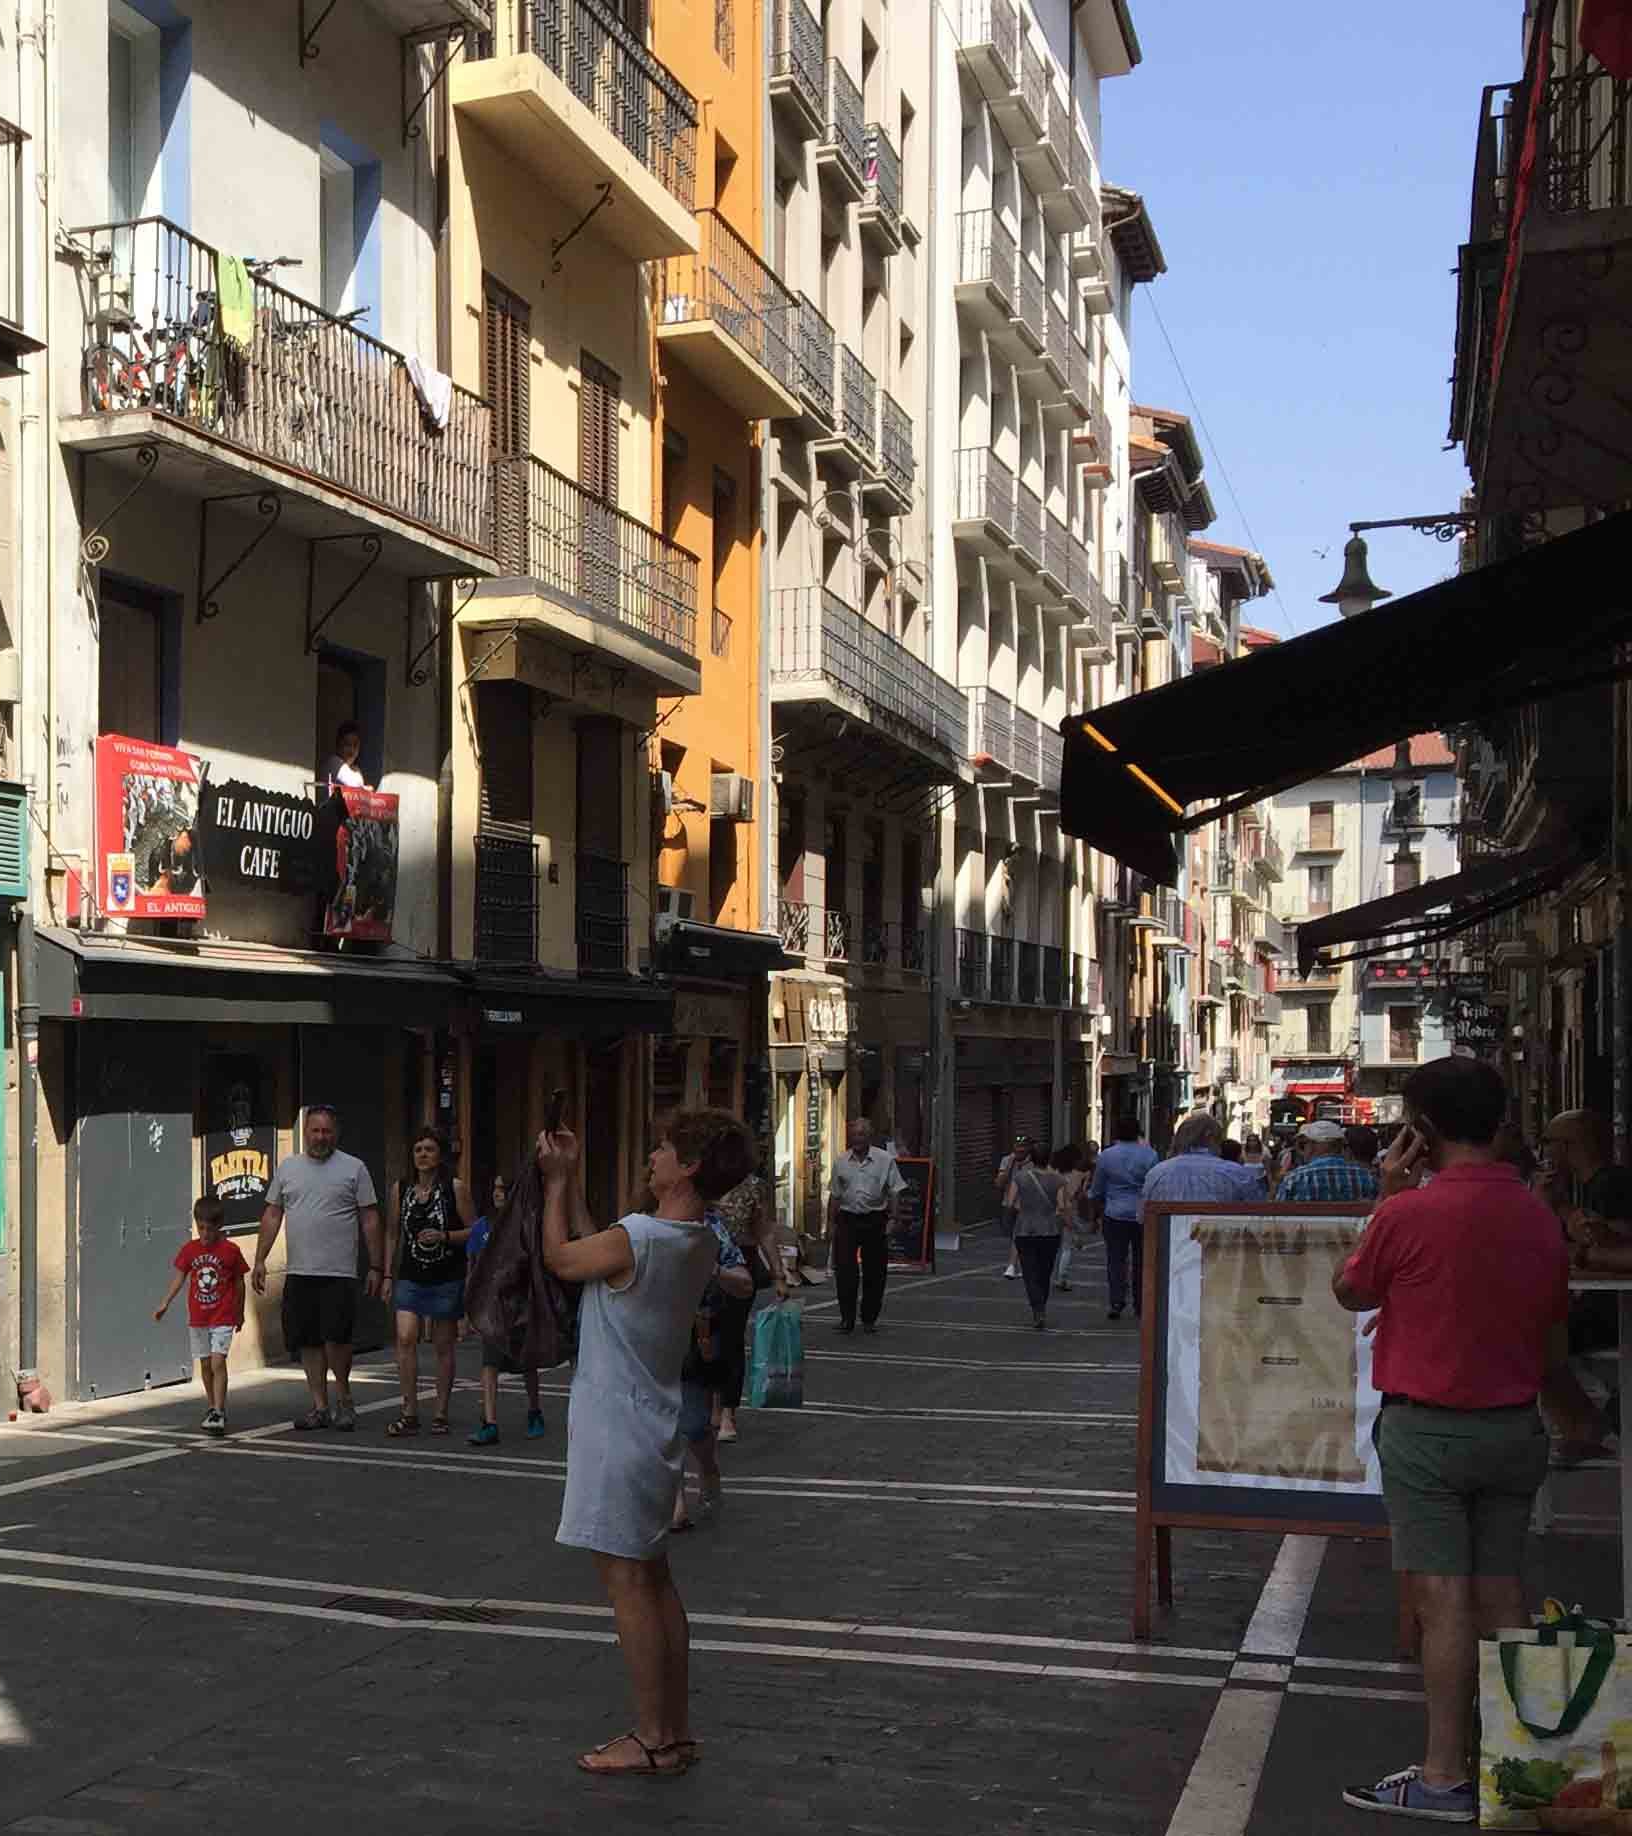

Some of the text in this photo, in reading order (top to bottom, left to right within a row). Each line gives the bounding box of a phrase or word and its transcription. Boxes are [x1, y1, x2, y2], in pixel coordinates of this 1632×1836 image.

[216, 796, 237, 829] EL
[239, 801, 313, 840] ANTIGUO
[240, 845, 280, 879] CAFE
[146, 902, 160, 913] EL
